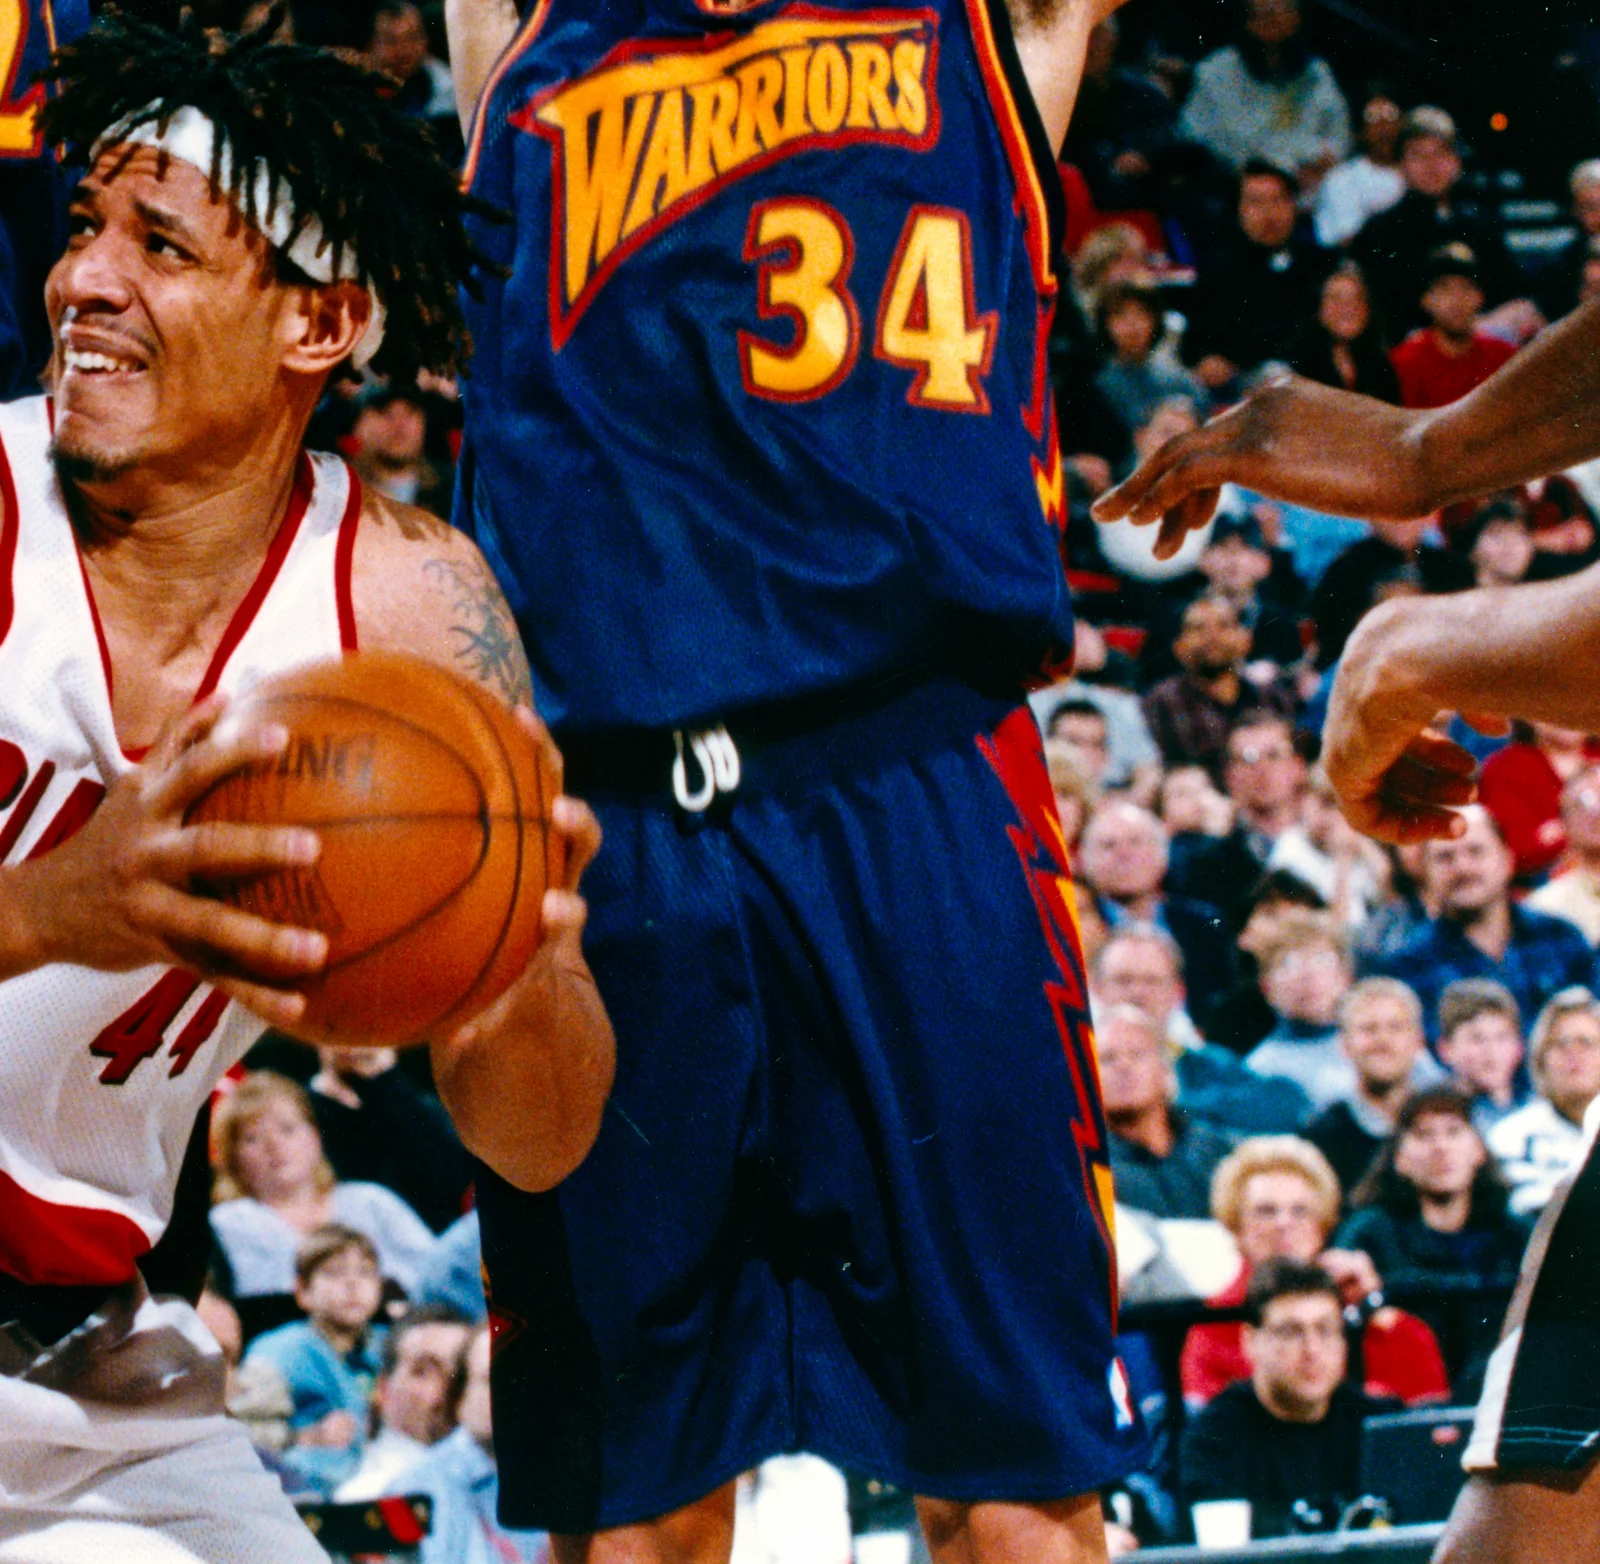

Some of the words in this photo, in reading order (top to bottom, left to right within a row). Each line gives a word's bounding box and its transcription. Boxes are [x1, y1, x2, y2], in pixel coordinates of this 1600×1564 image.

[518, 4, 936, 331] WARRIORS
[737, 196, 999, 416] 34
[88, 965, 234, 1086] 44
